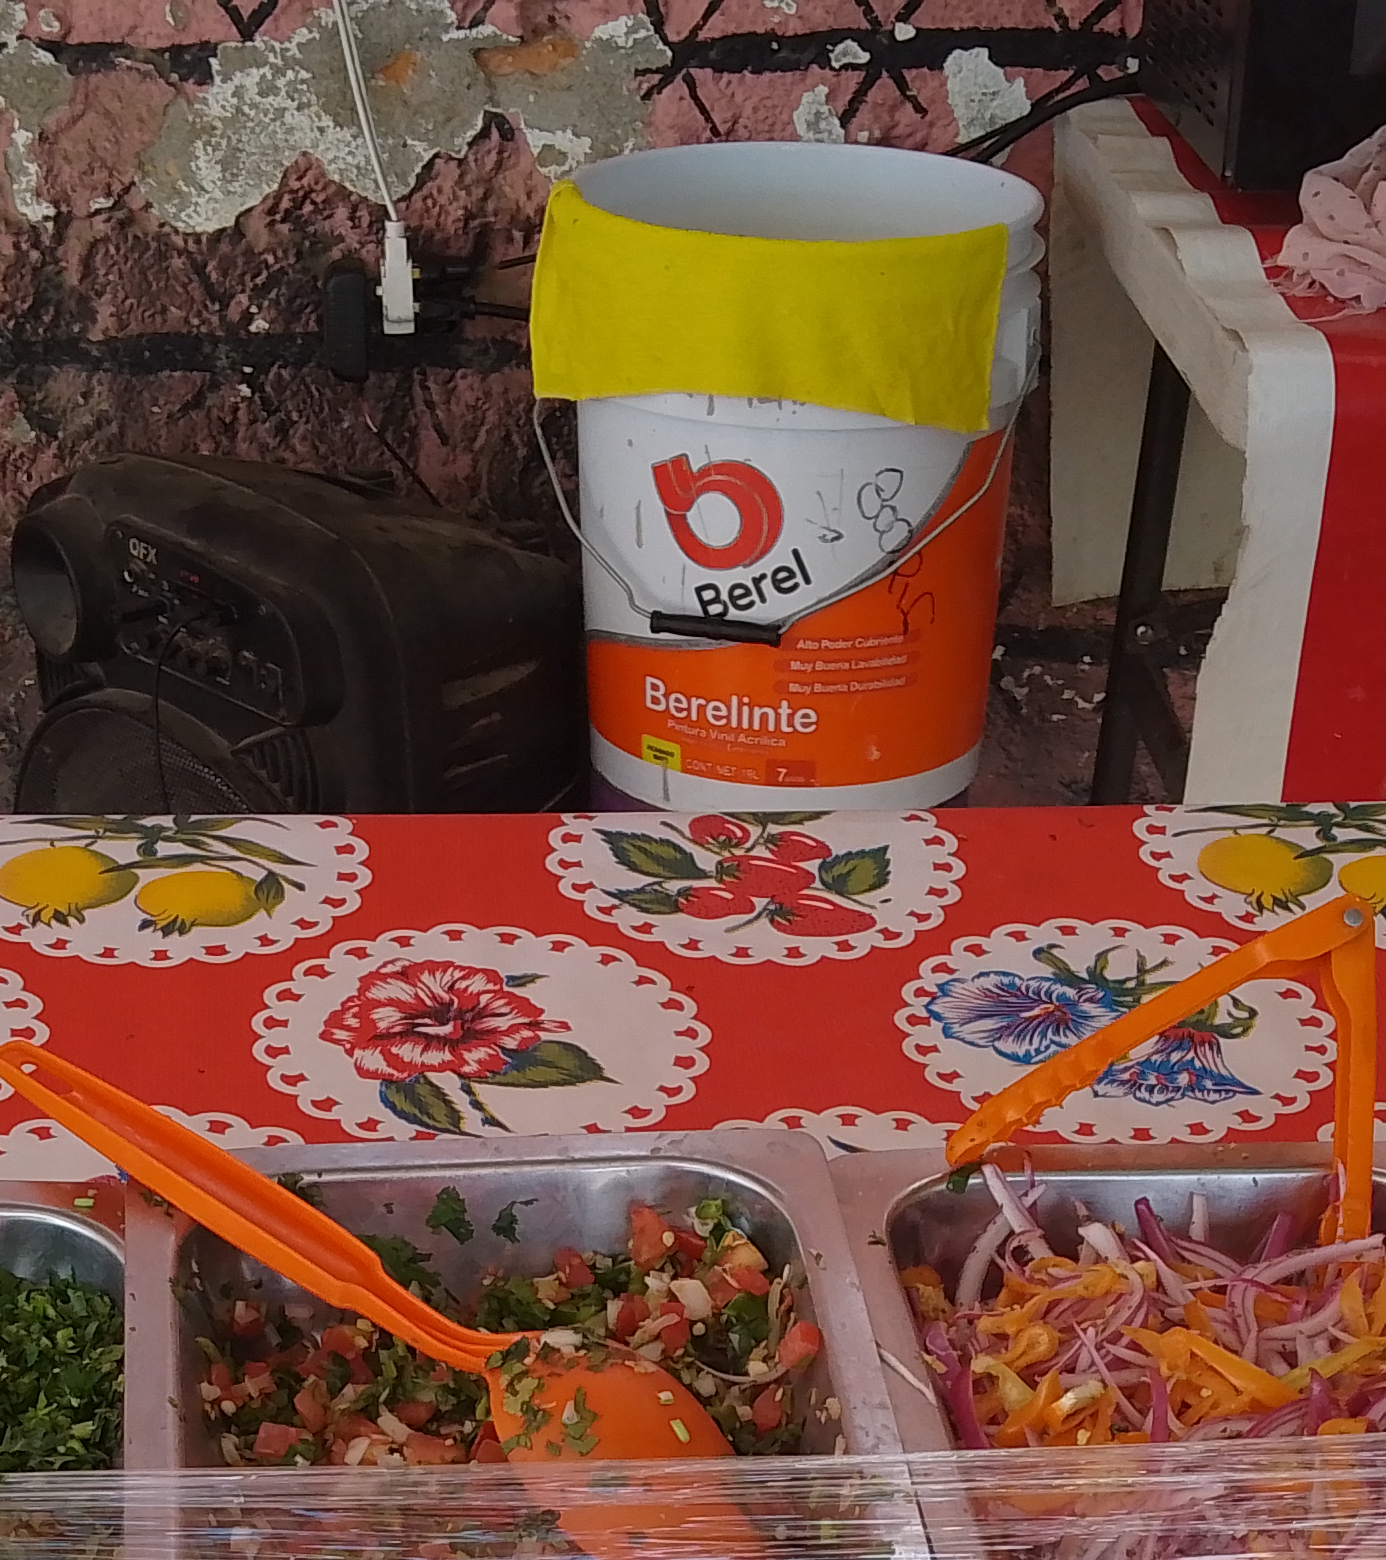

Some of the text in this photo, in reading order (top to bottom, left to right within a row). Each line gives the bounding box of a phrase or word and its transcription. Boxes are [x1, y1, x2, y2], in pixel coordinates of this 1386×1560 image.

[129, 538, 157, 564] QFX
[694, 548, 812, 619] Berel
[797, 638, 819, 649] Alto
[821, 639, 853, 649] Poder
[790, 661, 813, 673] Muy
[815, 661, 850, 671] Buena
[788, 683, 812, 695] Muy
[814, 683, 848, 693] Buena
[645, 676, 818, 733] Berelinte
[667, 719, 707, 738] Pintura
